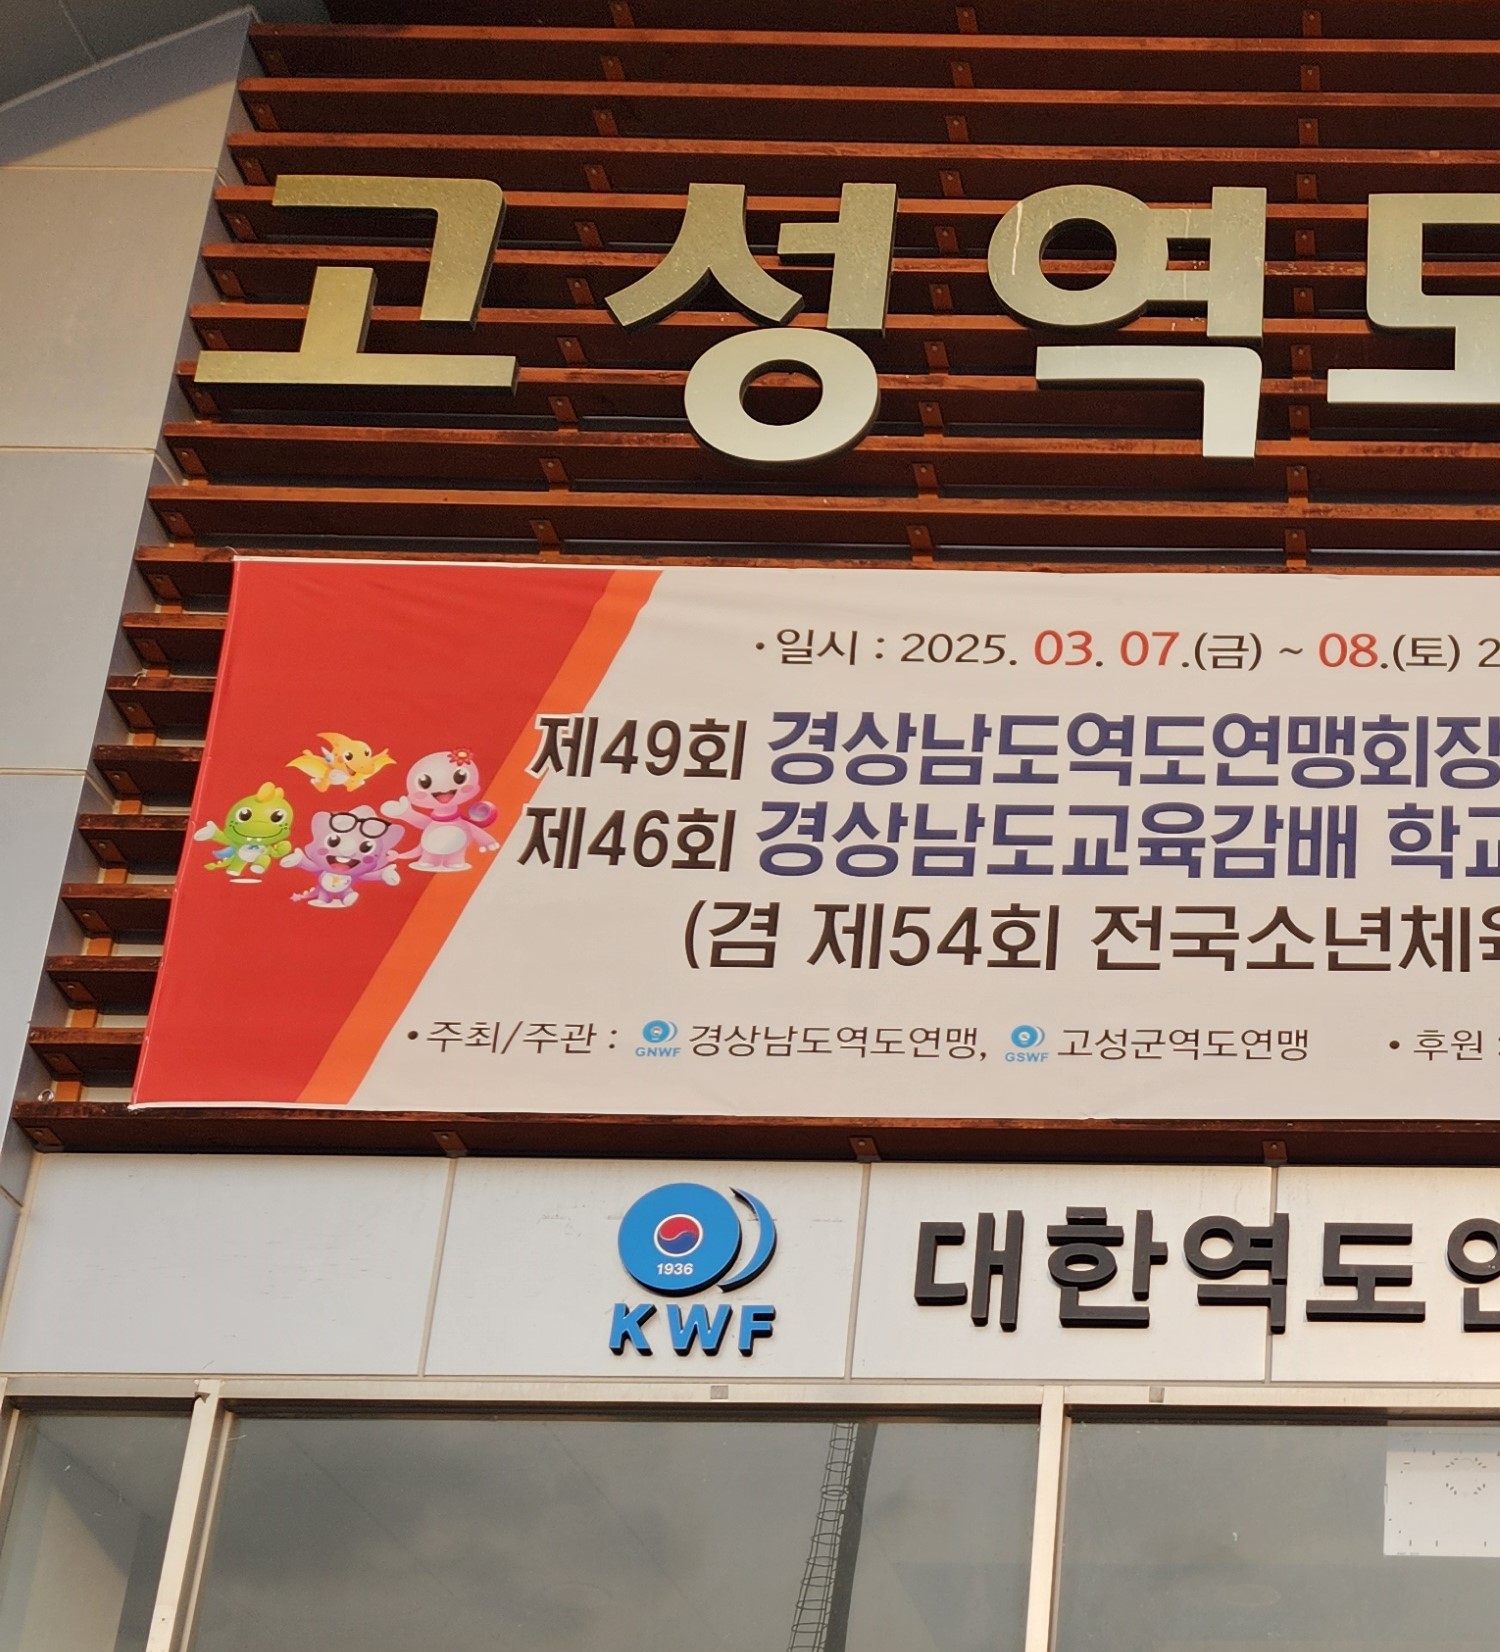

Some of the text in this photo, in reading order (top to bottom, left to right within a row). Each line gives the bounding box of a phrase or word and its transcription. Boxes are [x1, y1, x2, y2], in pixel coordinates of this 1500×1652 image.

[775, 627, 859, 667] 일시
[899, 632, 1018, 667] 2025.
[1033, 630, 1104, 668] 03.
[1118, 630, 1263, 672] 07.(금)
[1317, 632, 1460, 673] 08.(토)
[531, 714, 748, 782] 제49회
[517, 806, 738, 874] 제46회
[755, 800, 1358, 881] 경상남도교육감배
[684, 899, 780, 970] (겸
[807, 902, 1061, 972] 제54회
[425, 1020, 598, 1056] 주최/주관
[688, 1022, 988, 1062] 경상남도역도연맹,
[1056, 1027, 1310, 1063] 고성군역도연맹
[634, 1045, 682, 1058] GNWF
[1004, 1050, 1050, 1063] GSWF
[1412, 1028, 1484, 1063] 후원
[656, 1262, 694, 1276] 1936
[608, 1302, 778, 1358] KWF
